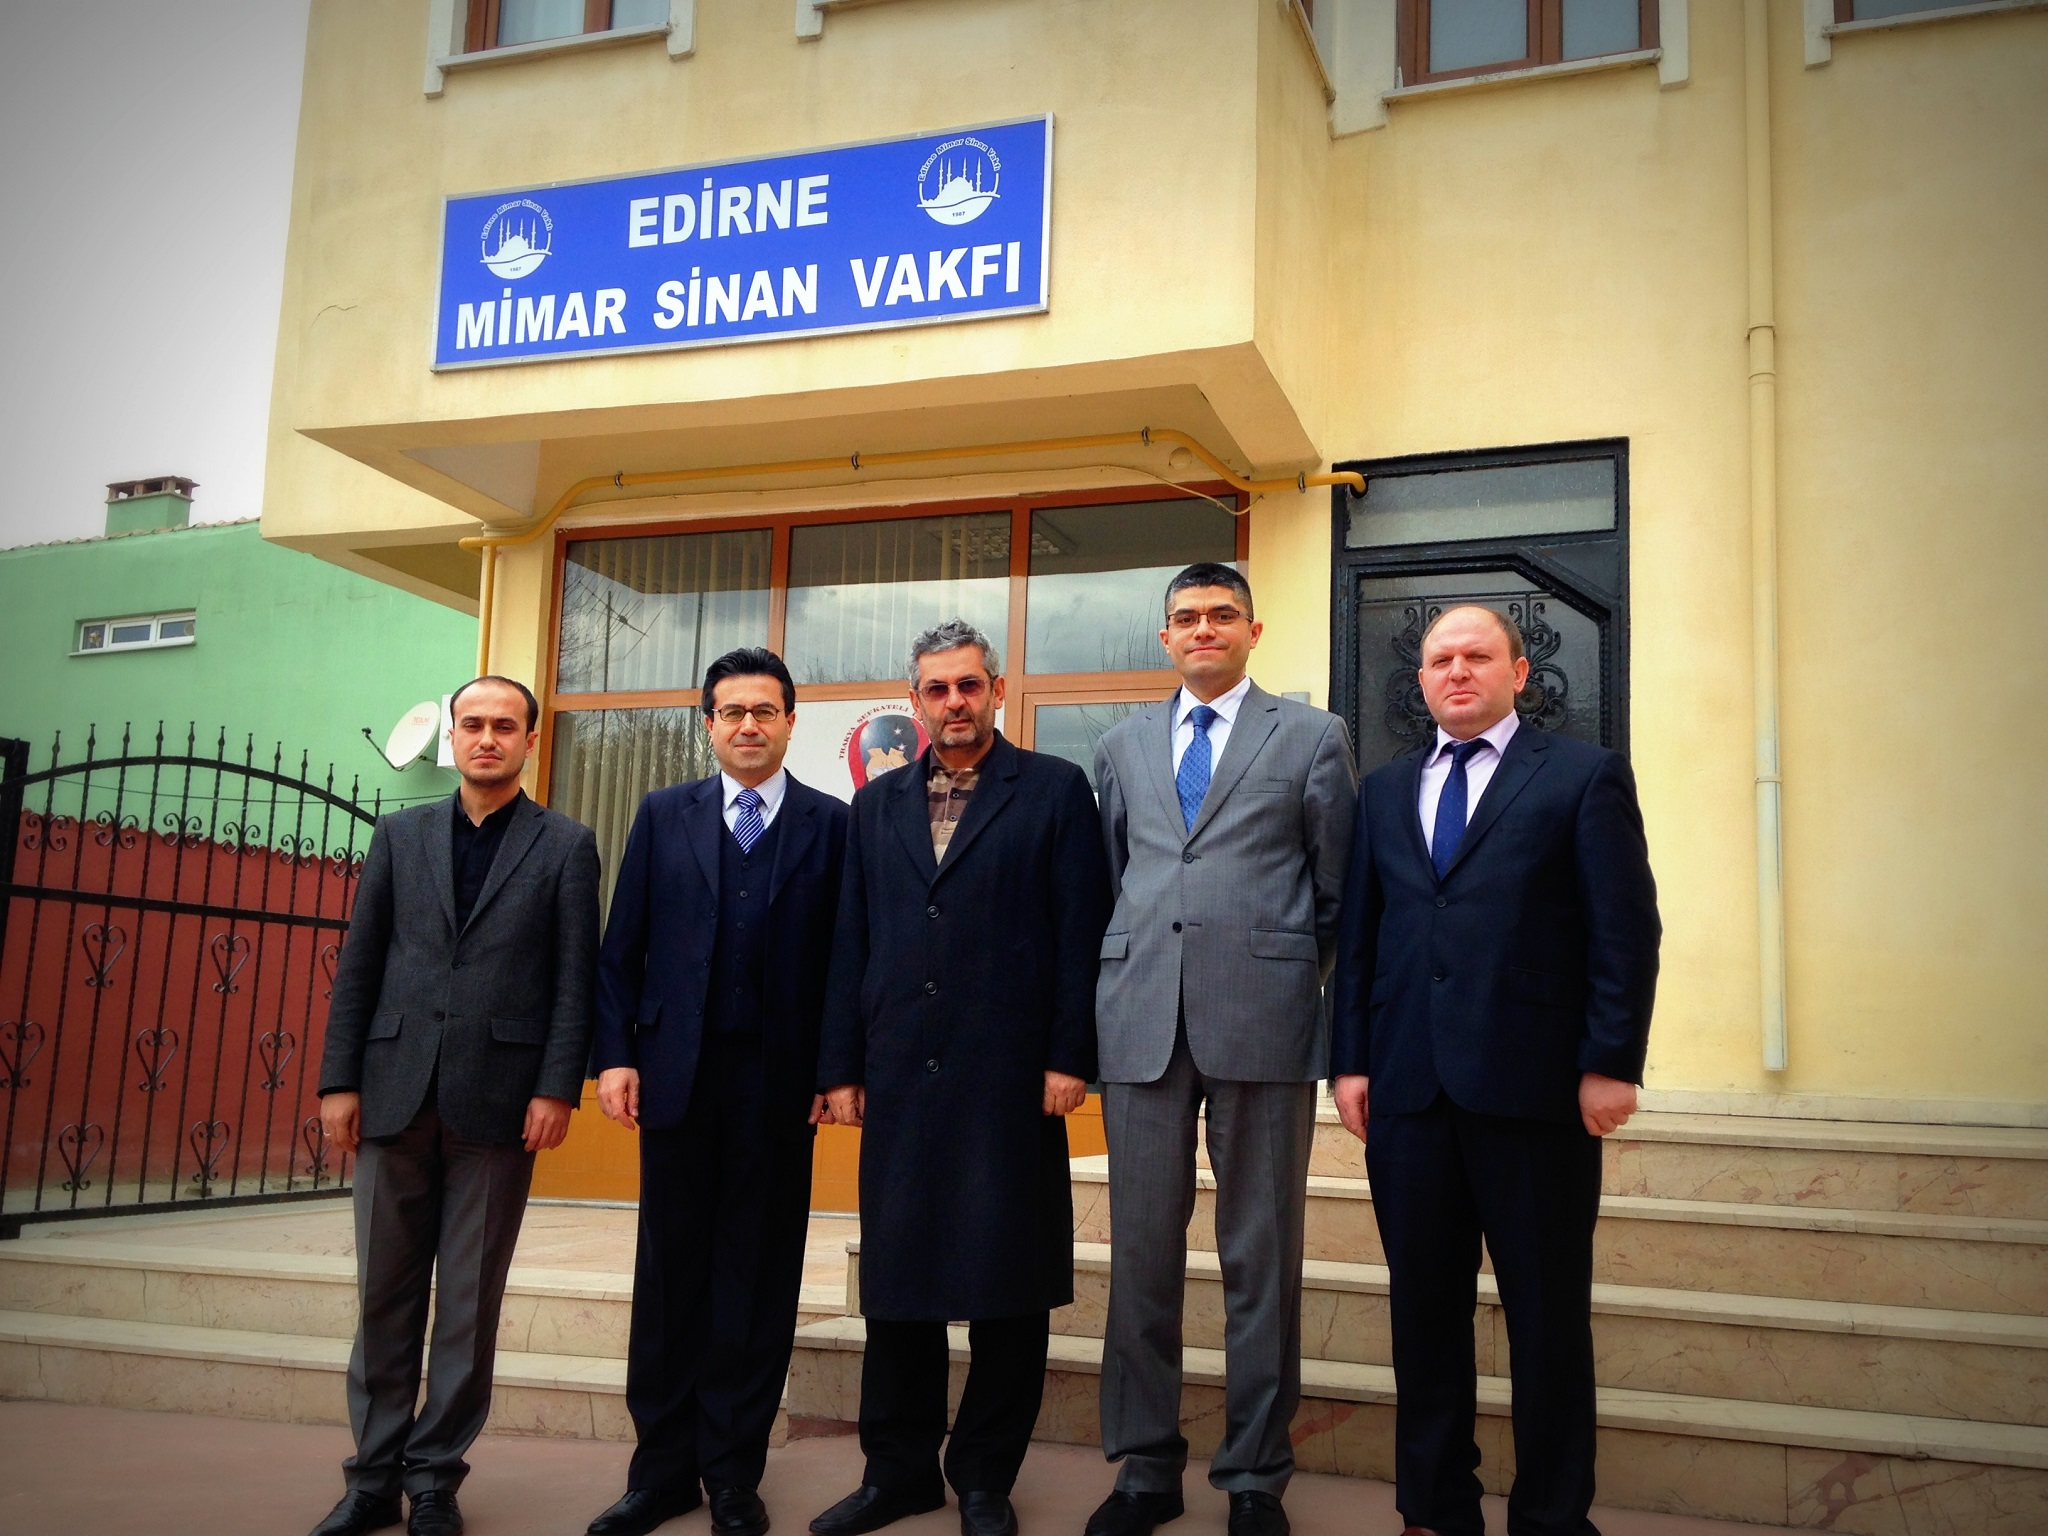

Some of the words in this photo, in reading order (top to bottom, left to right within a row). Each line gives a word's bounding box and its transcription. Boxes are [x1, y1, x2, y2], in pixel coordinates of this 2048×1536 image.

[936, 139, 964, 155] Mimar
[965, 137, 988, 153] Sinan
[628, 174, 829, 249] EDİRNE
[455, 287, 627, 350] MİMAR
[653, 263, 818, 330] SİNAN
[849, 241, 1021, 308] VAKFI
